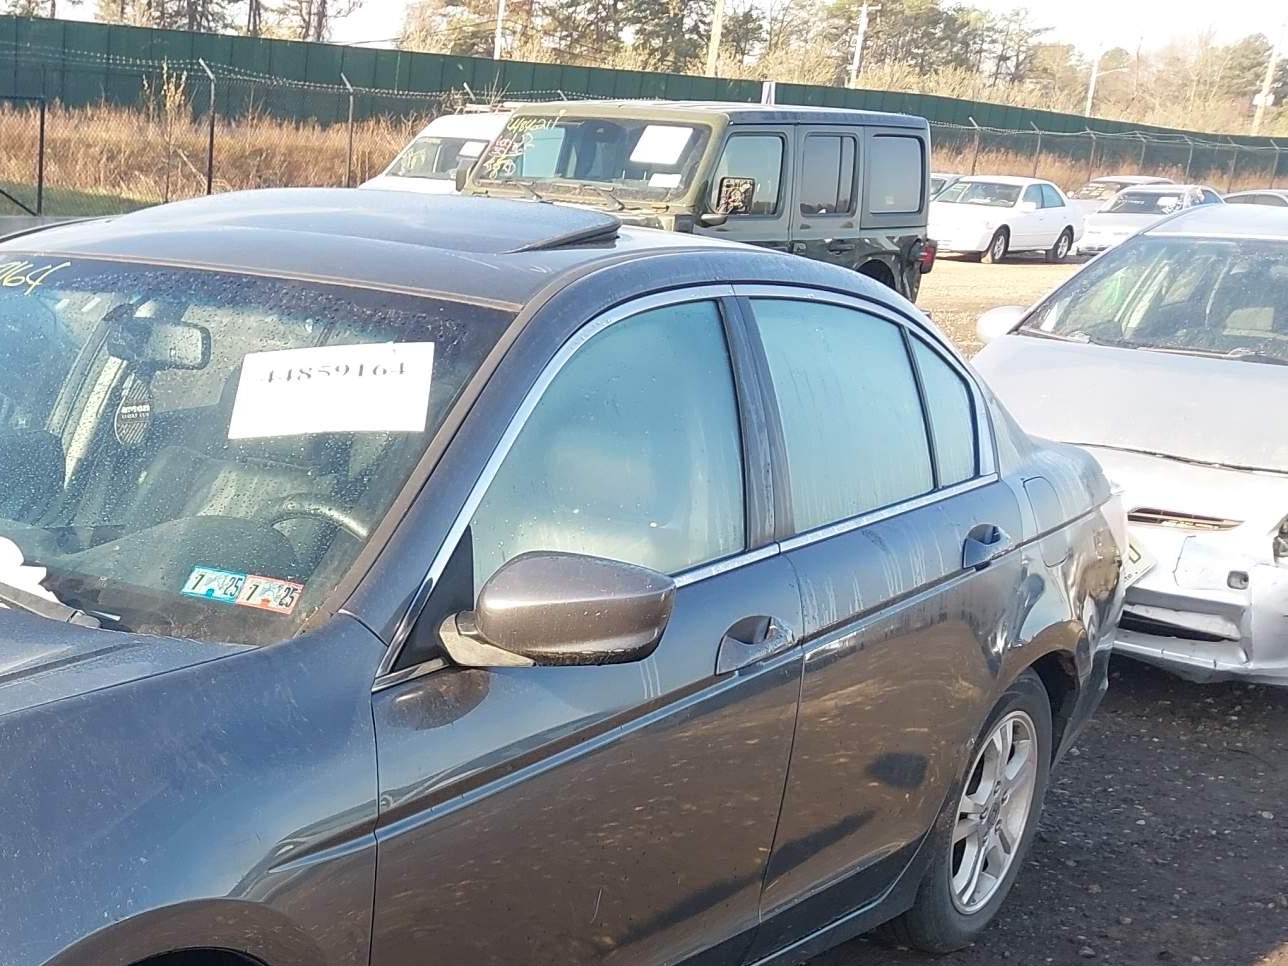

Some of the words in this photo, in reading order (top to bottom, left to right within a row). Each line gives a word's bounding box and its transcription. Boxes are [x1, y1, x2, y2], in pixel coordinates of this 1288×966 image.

[261, 362, 409, 384] 44859164
[192, 573, 205, 591] 7
[223, 576, 243, 598] 25
[246, 584, 260, 602] 7
[278, 586, 299, 608] 25
